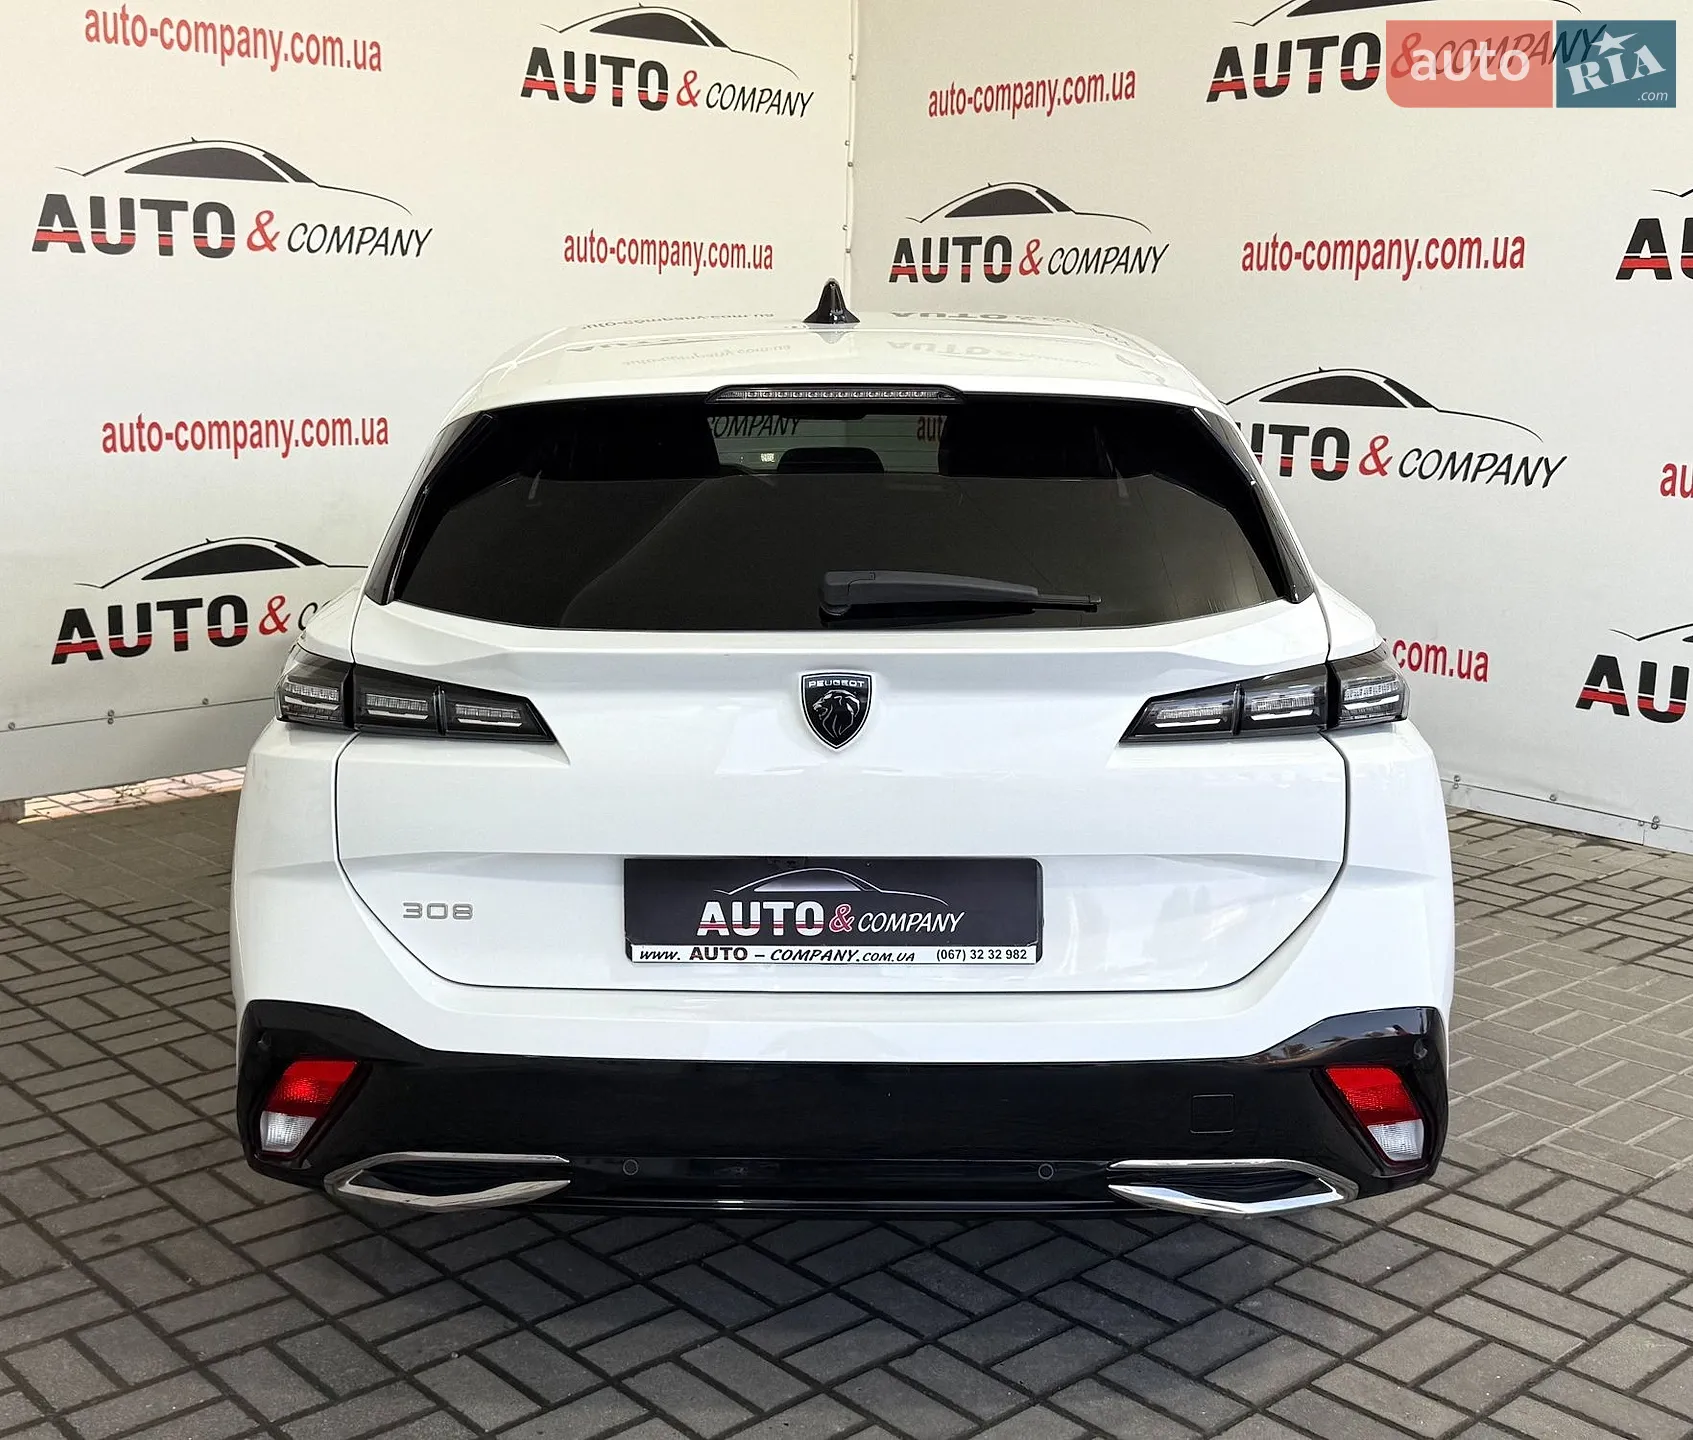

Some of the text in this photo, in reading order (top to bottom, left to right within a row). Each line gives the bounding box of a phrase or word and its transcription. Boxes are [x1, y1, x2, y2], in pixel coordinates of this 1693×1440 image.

[85, 4, 382, 72] auto-company.com.ua
[521, 46, 814, 117] AUTO & COMPANY
[1206, 32, 1381, 102] AUTO
[929, 71, 1136, 119] auto-company.com.ua
[32, 194, 433, 258] AUTO & COMPANY
[564, 229, 773, 276] auto-company.com.ua
[889, 235, 1169, 283] AUTO & COMPANY
[1242, 232, 1525, 281] auto-company.com.ua
[102, 413, 389, 459] auto-company.com.ua
[711, 415, 799, 438] OMPANY
[1359, 435, 1393, 476] &
[1399, 448, 1567, 488] COMPANY
[51, 595, 248, 665] AUTO
[258, 595, 291, 635] &
[808, 680, 865, 688] PEUGEOT
[1391, 640, 1489, 682] com.ua
[403, 902, 473, 920] 308
[697, 901, 965, 936] AUTO & COMPANY
[639, 950, 681, 960] www.
[689, 946, 748, 961] AUTO
[936, 949, 1027, 962] (067) 32 32 982
